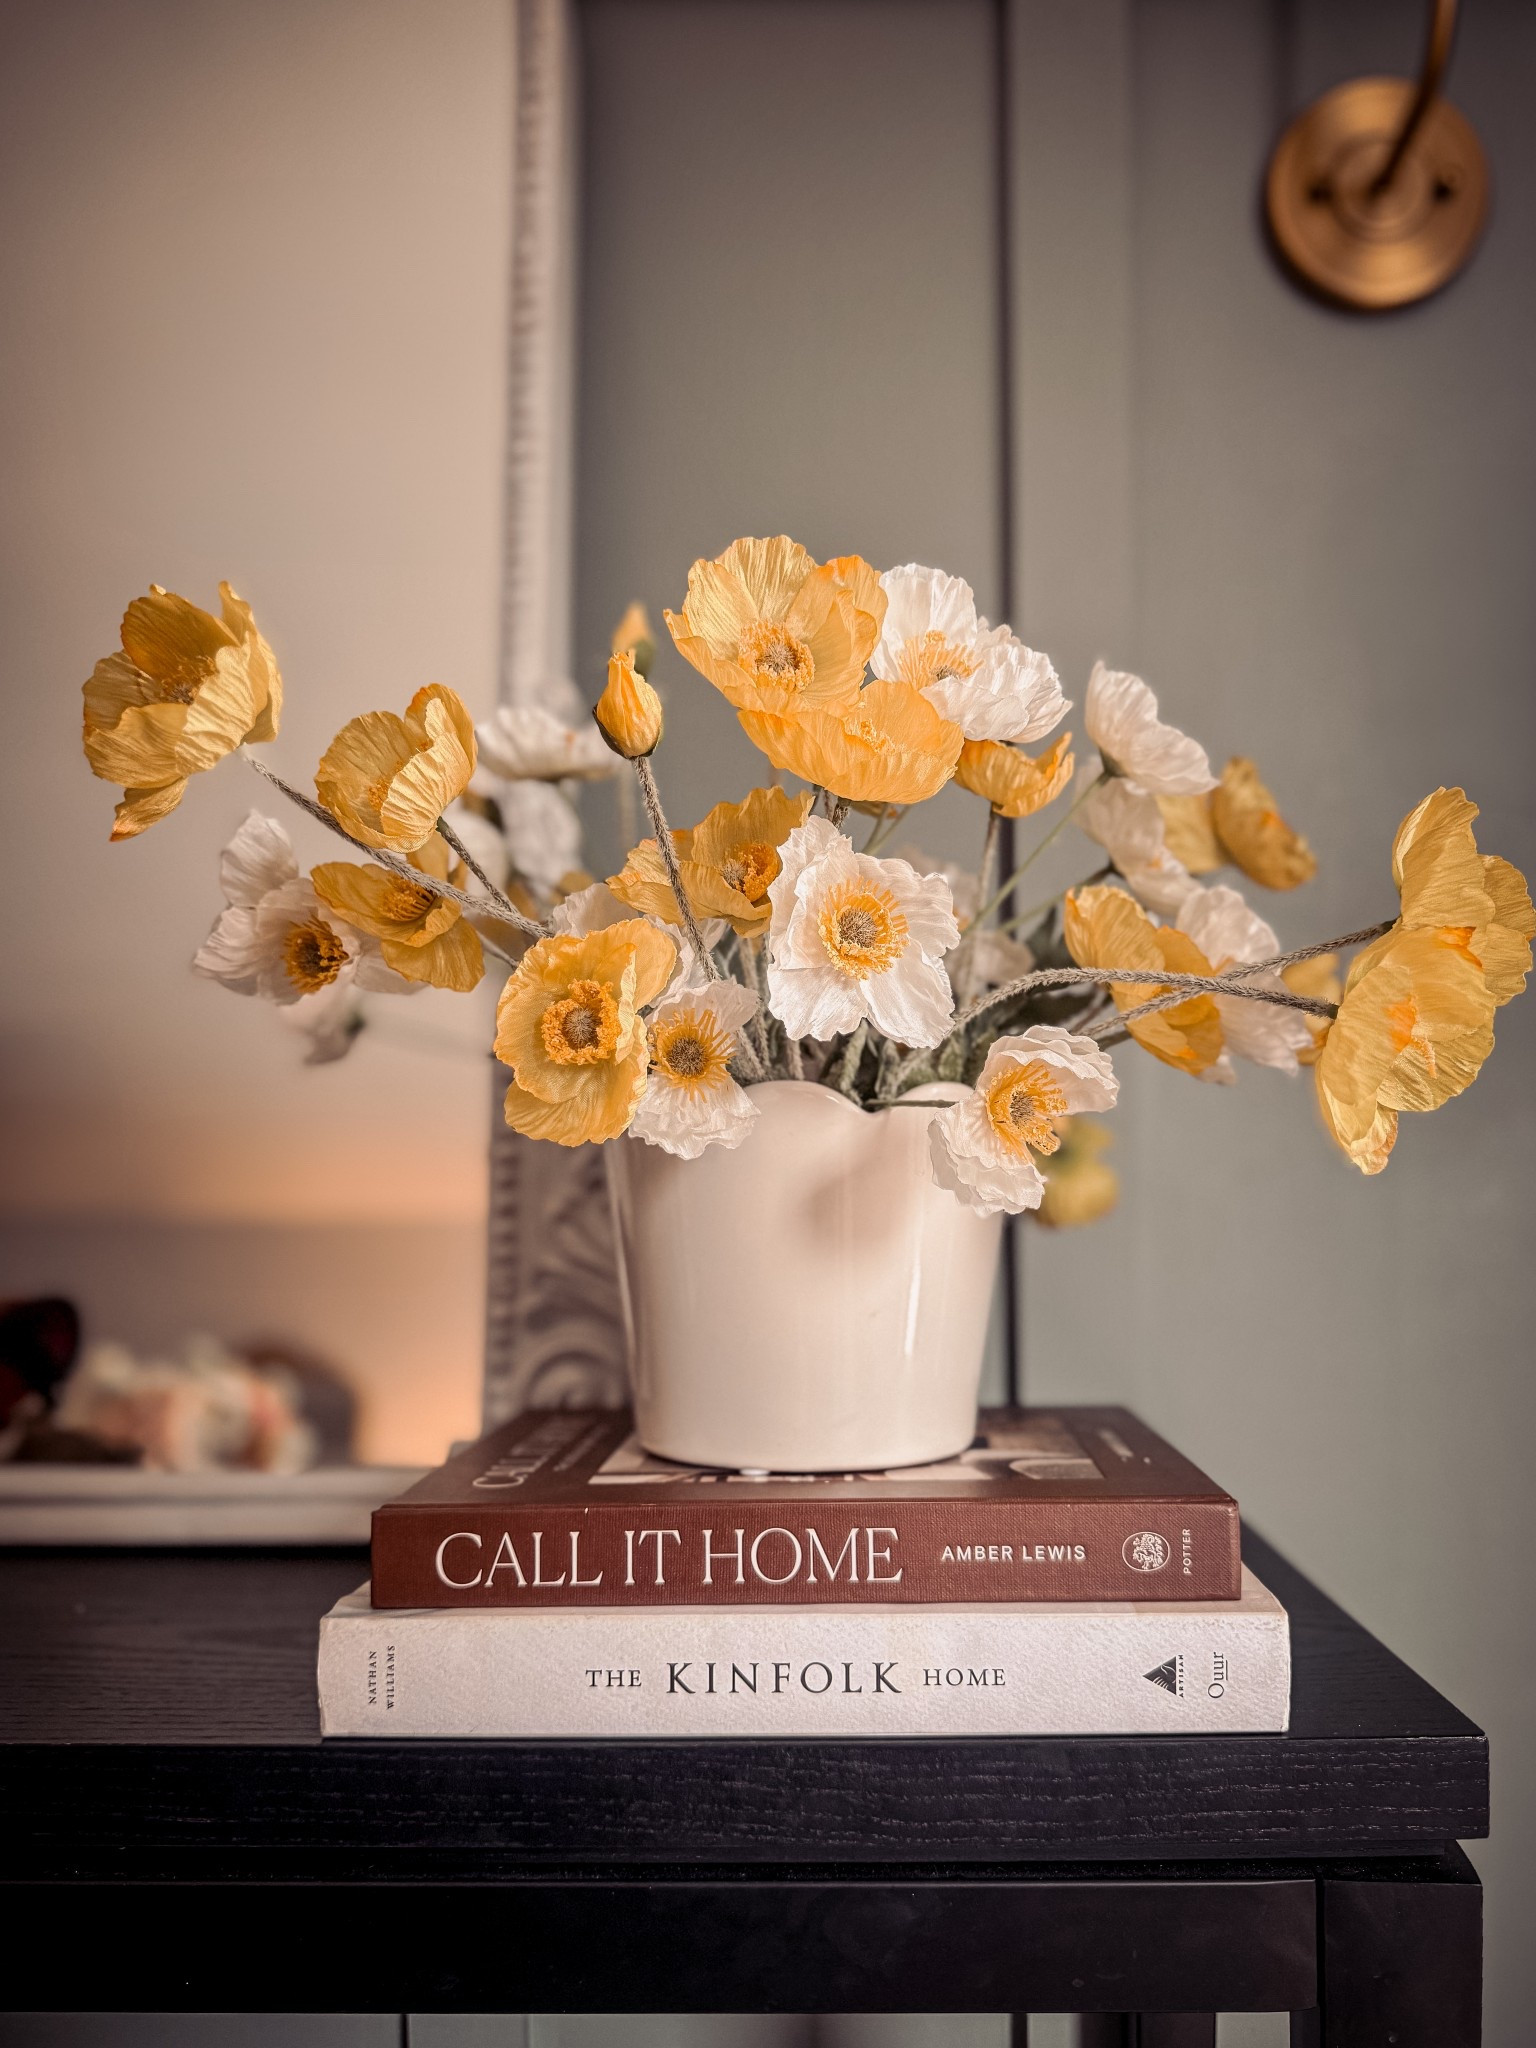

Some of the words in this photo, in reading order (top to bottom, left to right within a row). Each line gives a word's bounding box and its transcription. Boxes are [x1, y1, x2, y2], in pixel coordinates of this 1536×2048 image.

[435, 1531, 603, 1590] CALL
[624, 1529, 682, 1587] IT
[701, 1527, 903, 1586] HOME
[941, 1544, 1014, 1562] AMBER
[1022, 1544, 1087, 1562] LEWIS
[1182, 1528, 1192, 1575] POTTER
[368, 1651, 377, 1705] NATHAN
[386, 1645, 395, 1710] WILLIAMS
[585, 1669, 642, 1688] THE
[666, 1661, 902, 1694] KINFOLK
[923, 1668, 1006, 1687] HOME
[1207, 1651, 1226, 1699] Ouur
